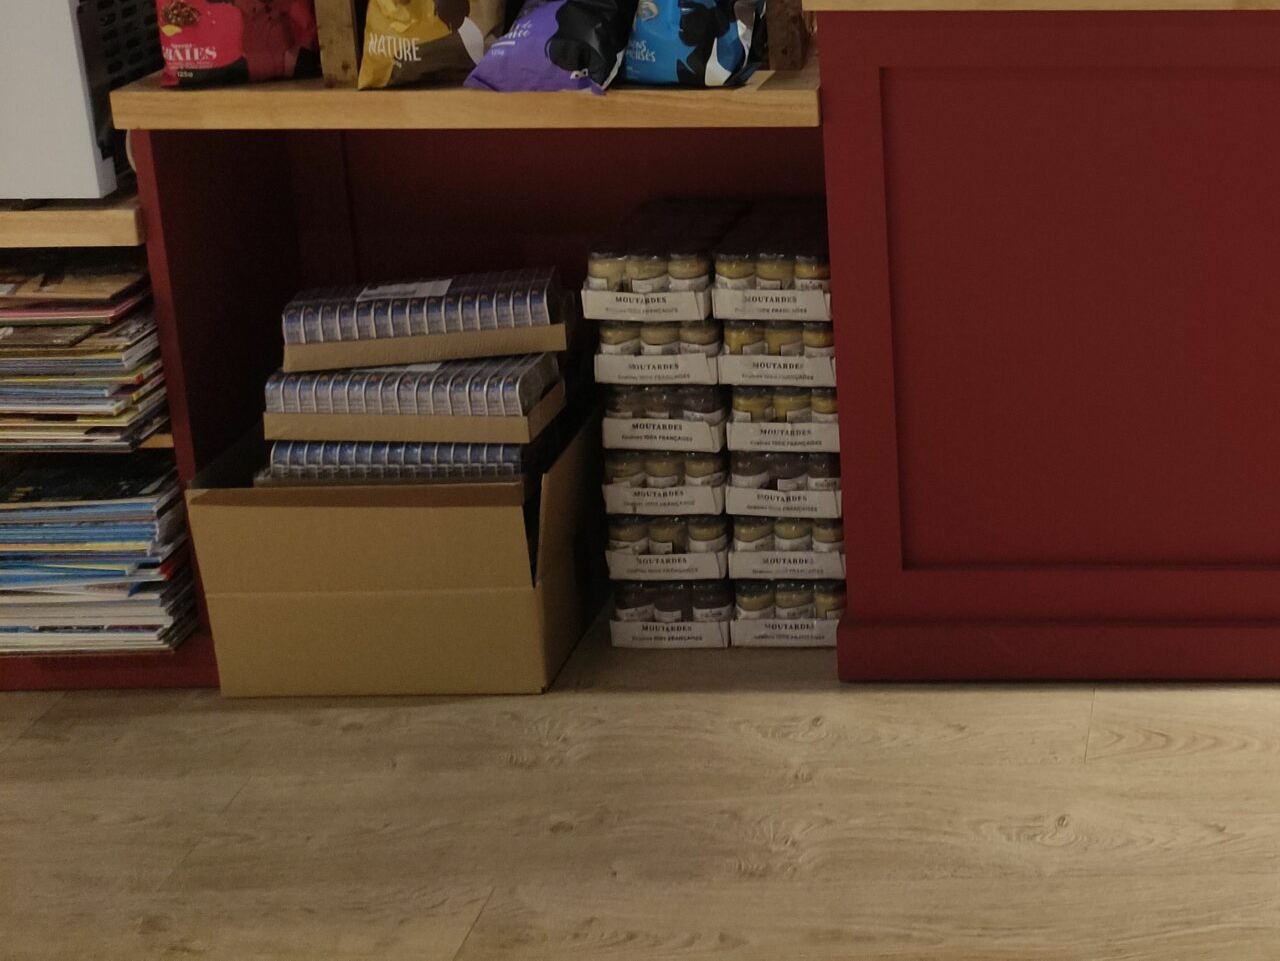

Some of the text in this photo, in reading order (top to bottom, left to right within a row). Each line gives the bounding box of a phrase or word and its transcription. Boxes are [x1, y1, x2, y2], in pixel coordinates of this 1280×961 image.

[369, 33, 422, 62] NATURE
[632, 423, 683, 431] MOUTARDES
[760, 429, 811, 437] MOUTARDES
[633, 490, 684, 498] MOUTARDES
